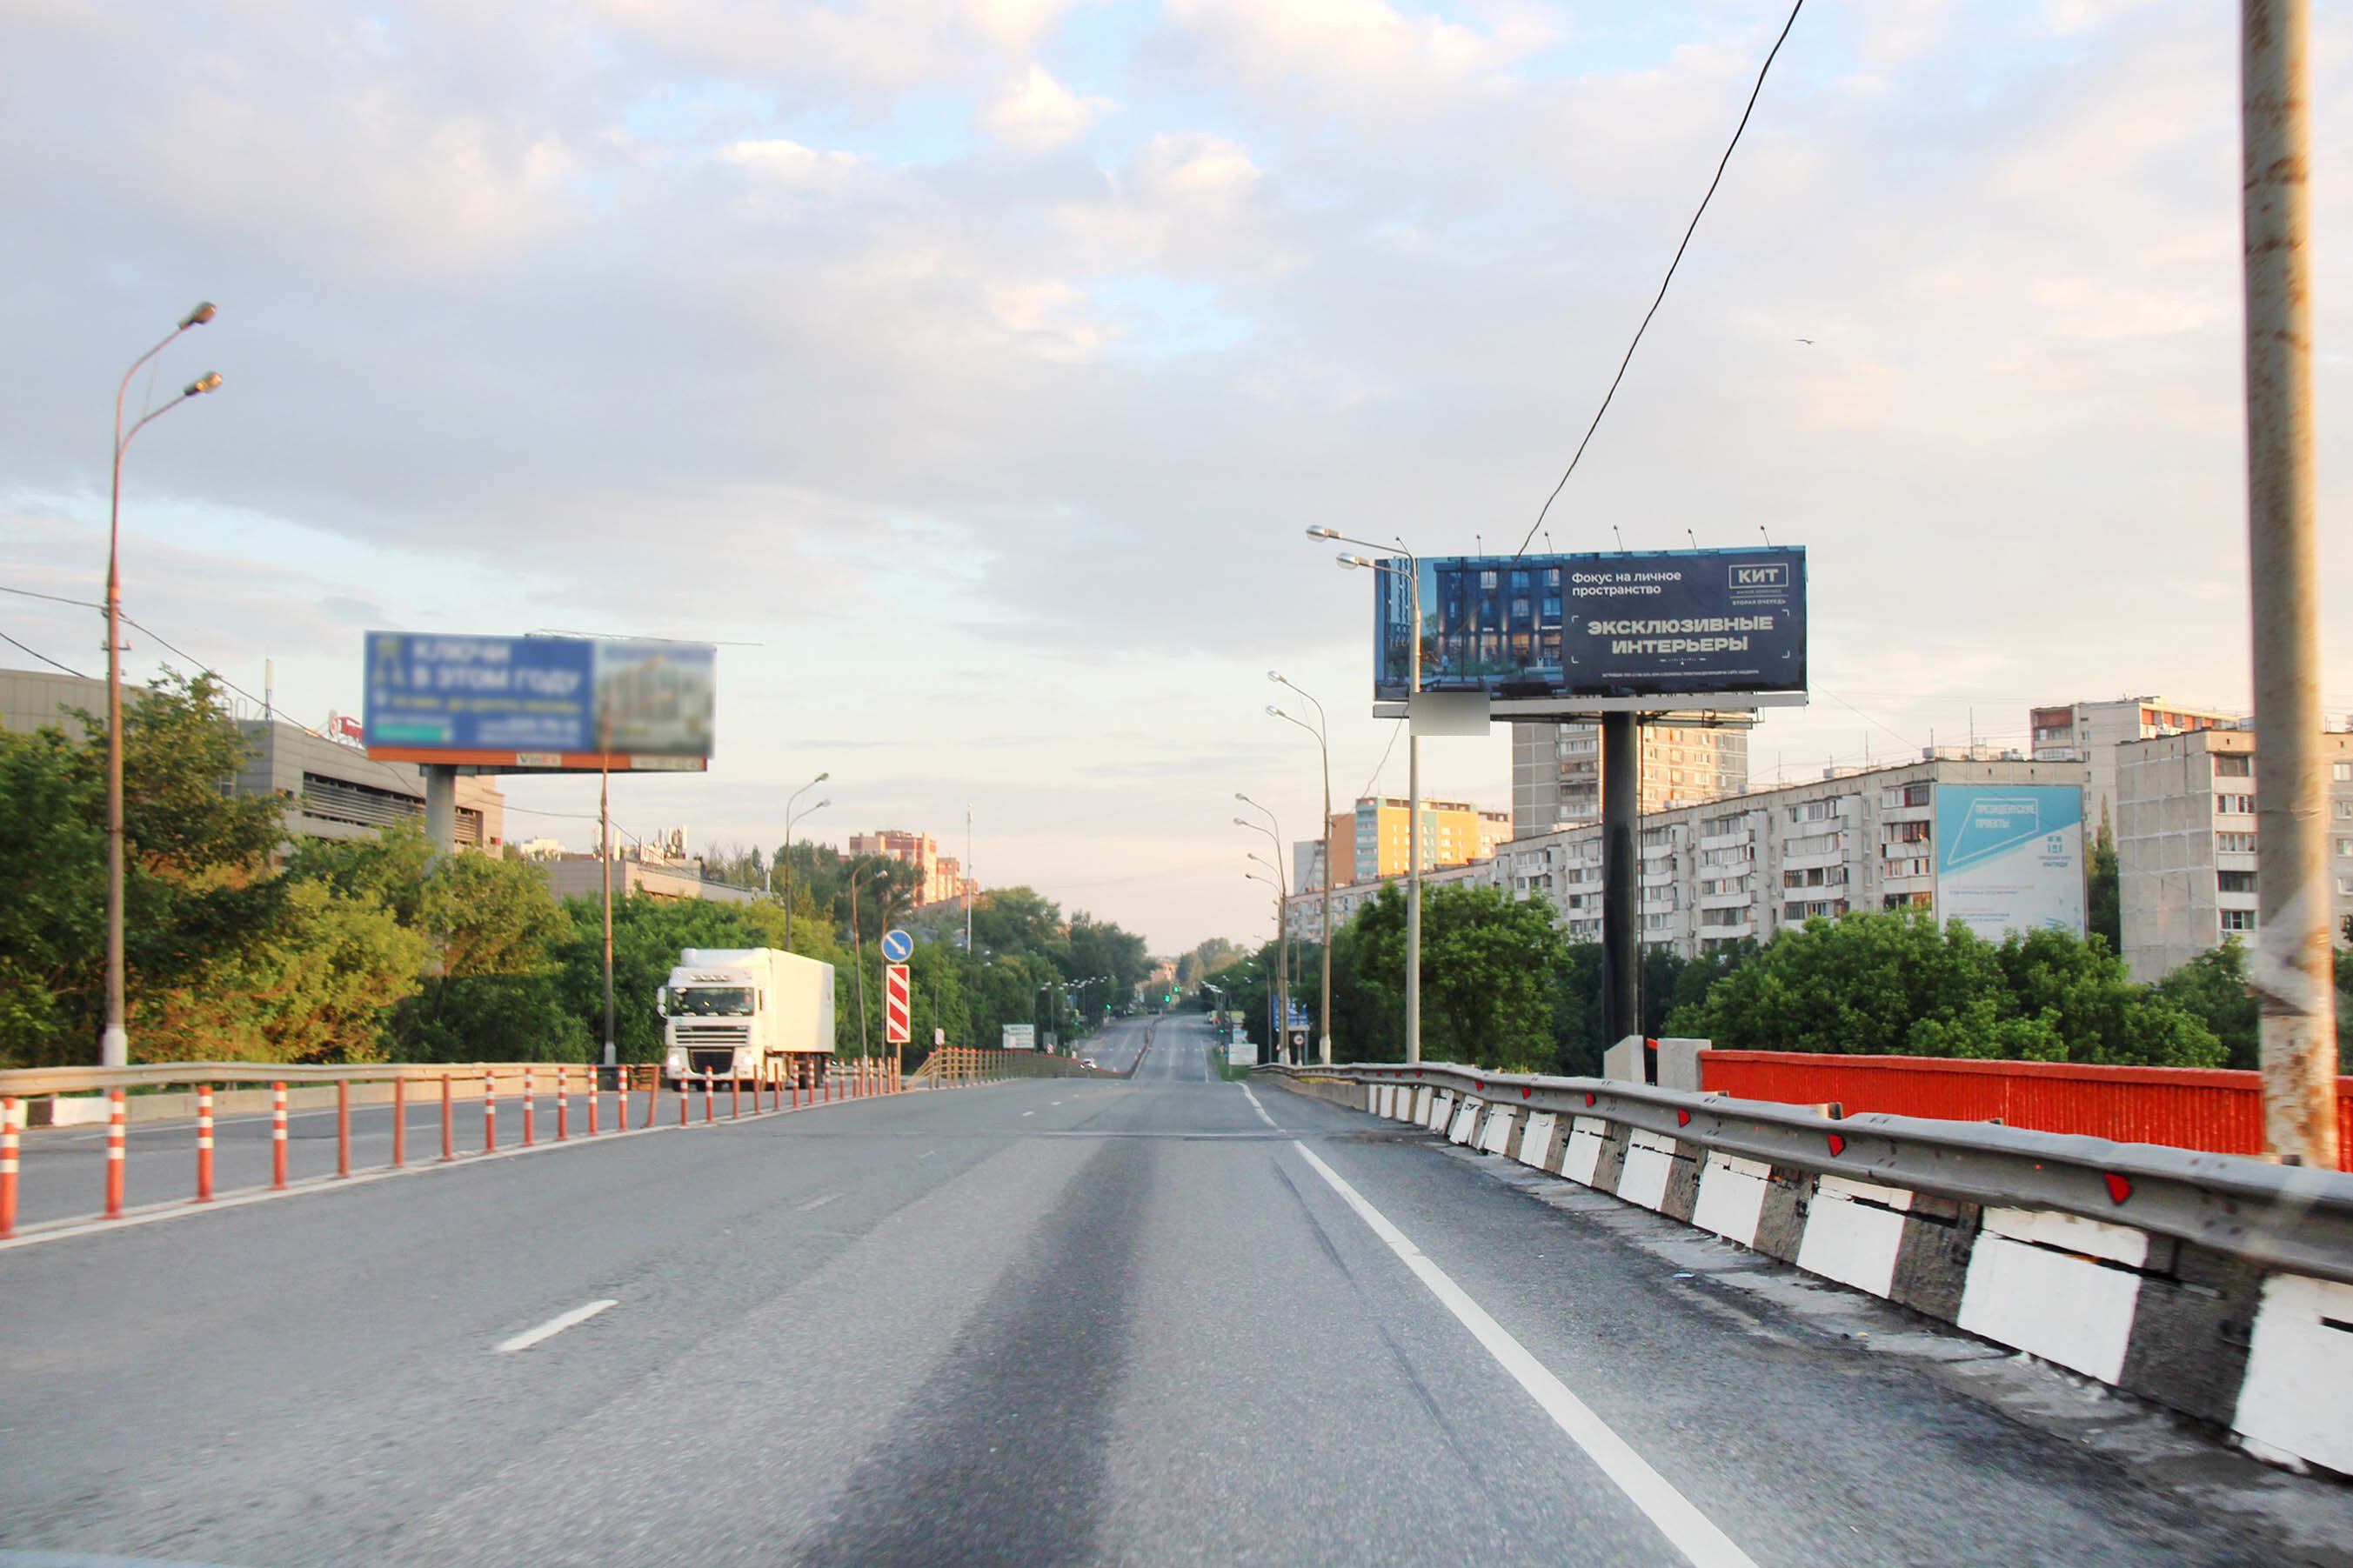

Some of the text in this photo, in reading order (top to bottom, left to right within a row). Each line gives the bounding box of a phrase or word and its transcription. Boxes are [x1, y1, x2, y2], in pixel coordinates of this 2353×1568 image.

[1572, 571, 1682, 585] Фокус на личное
[1738, 569, 1779, 584] КИТ
[1572, 585, 1661, 598] пространство
[1588, 616, 1774, 636] ЭКСКЛЮЗИВНЫЕ
[1612, 636, 1748, 655] ИНТЕРЬЕРЫ
